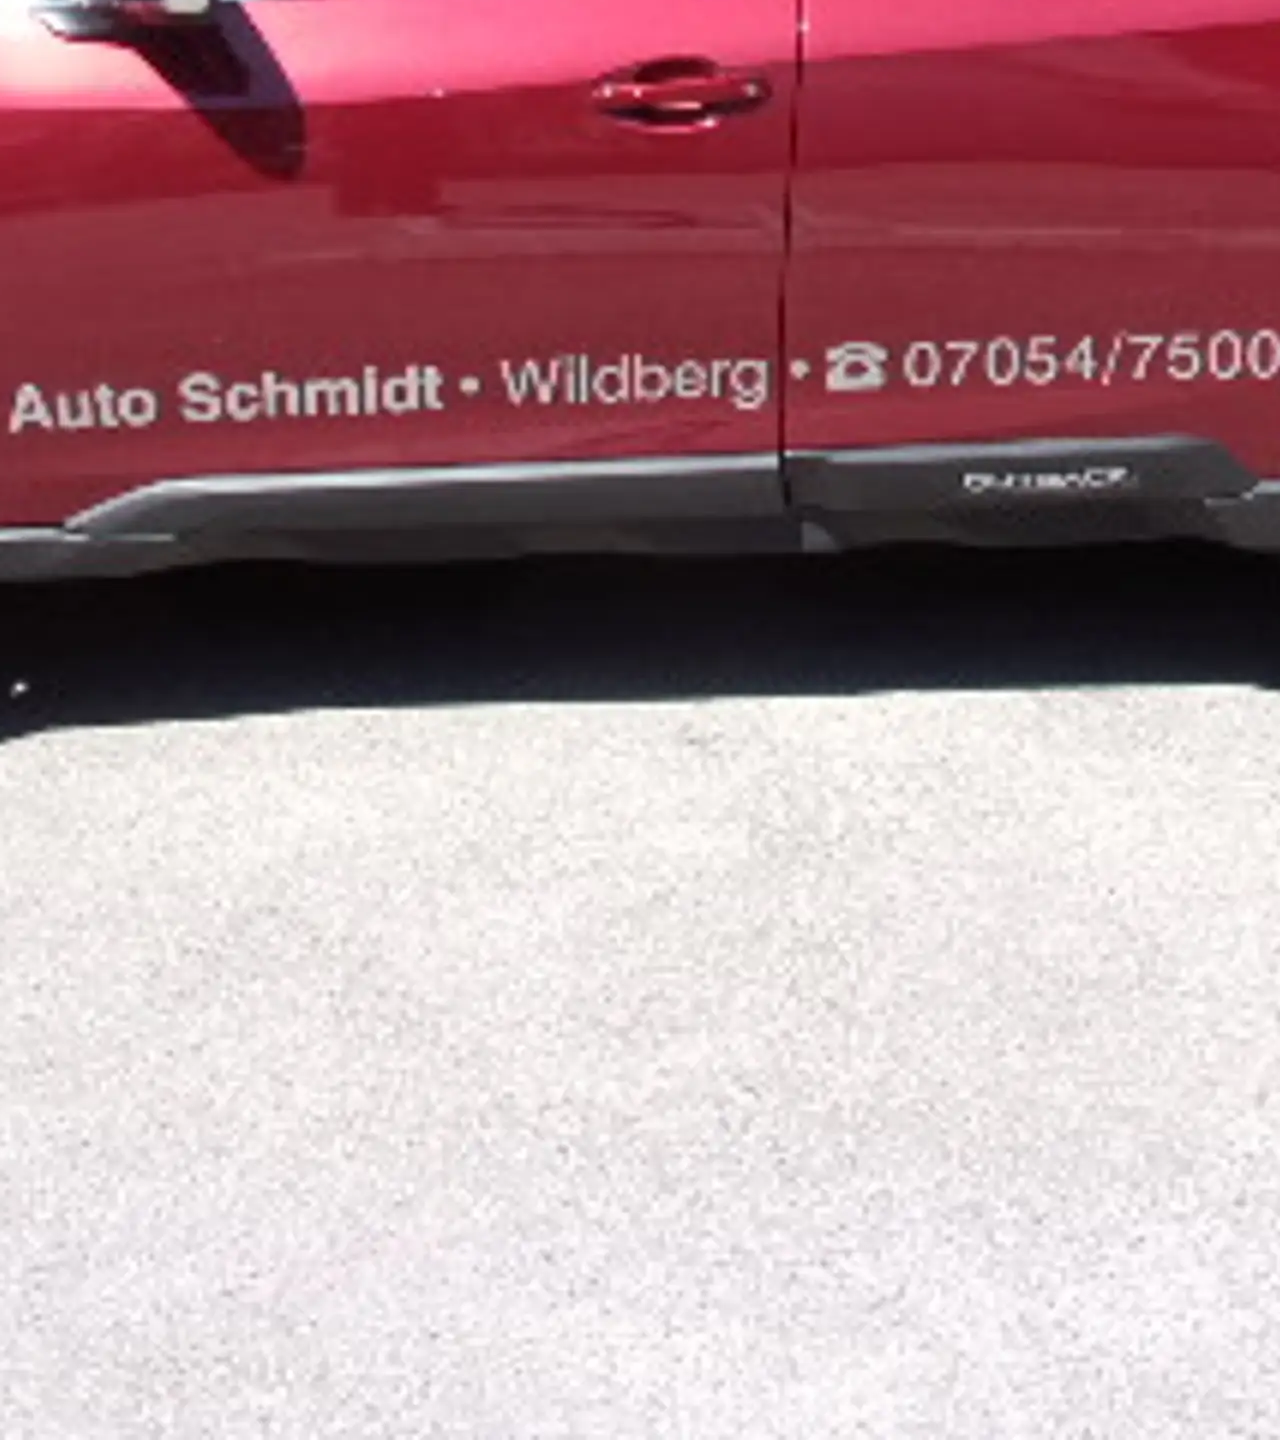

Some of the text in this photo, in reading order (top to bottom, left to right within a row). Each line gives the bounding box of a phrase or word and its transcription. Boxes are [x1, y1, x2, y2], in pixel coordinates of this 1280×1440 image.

[8, 382, 157, 434] Auto
[176, 364, 445, 423] Schmidt
[499, 353, 770, 410] Wildberg
